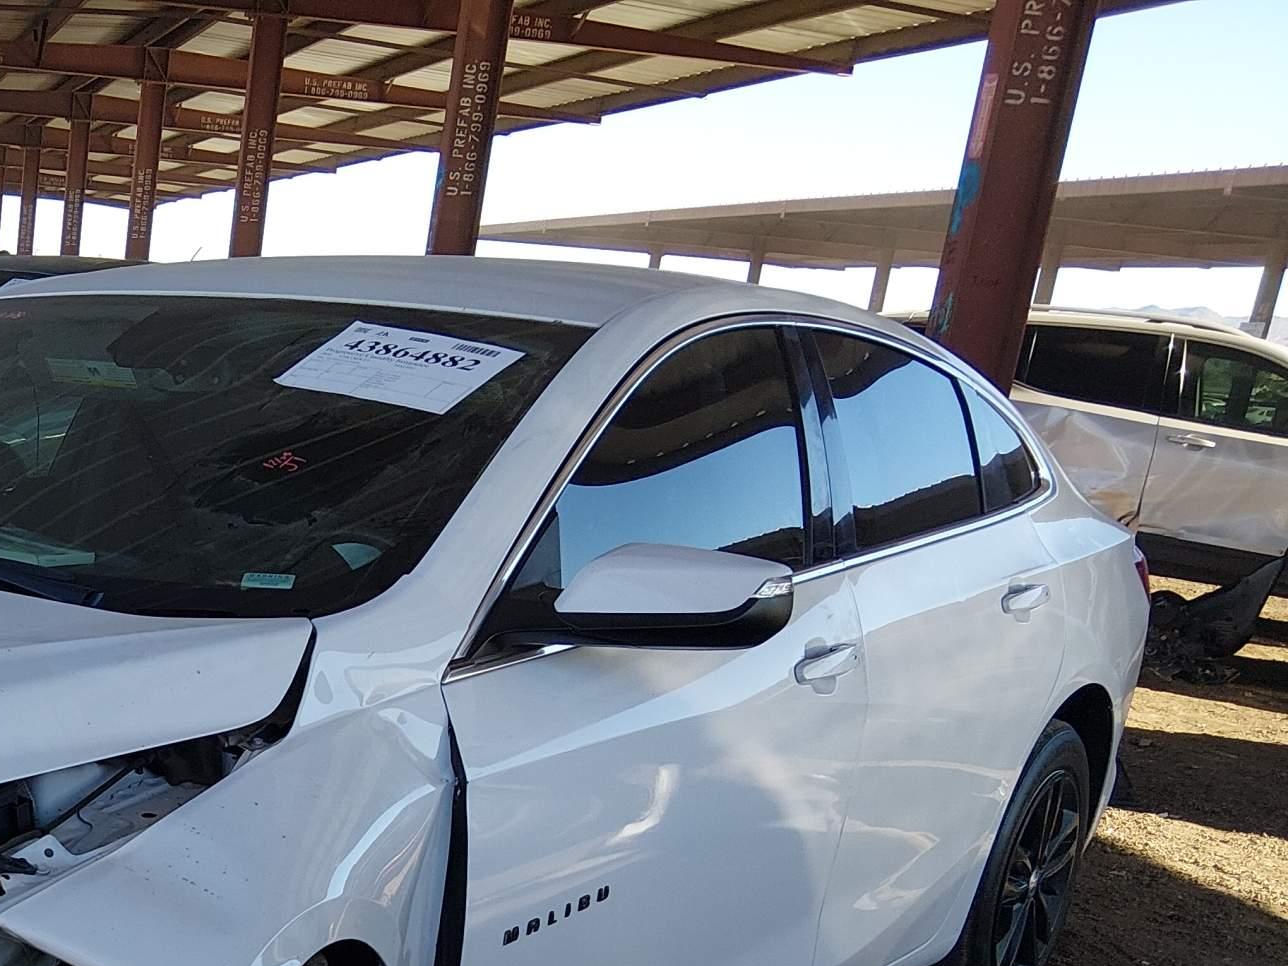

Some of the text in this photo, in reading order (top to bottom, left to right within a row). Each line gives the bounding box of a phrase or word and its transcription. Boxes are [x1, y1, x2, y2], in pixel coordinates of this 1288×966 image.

[535, 17, 552, 29] INC.
[322, 80, 352, 90] PREFAB
[1004, 53, 1035, 105] U.S.
[446, 60, 477, 196] U.S. PREFAB INC.
[460, 61, 491, 195] 1-866-799-0969
[344, 339, 481, 371] 43864882
[502, 885, 610, 946] MALIBU
